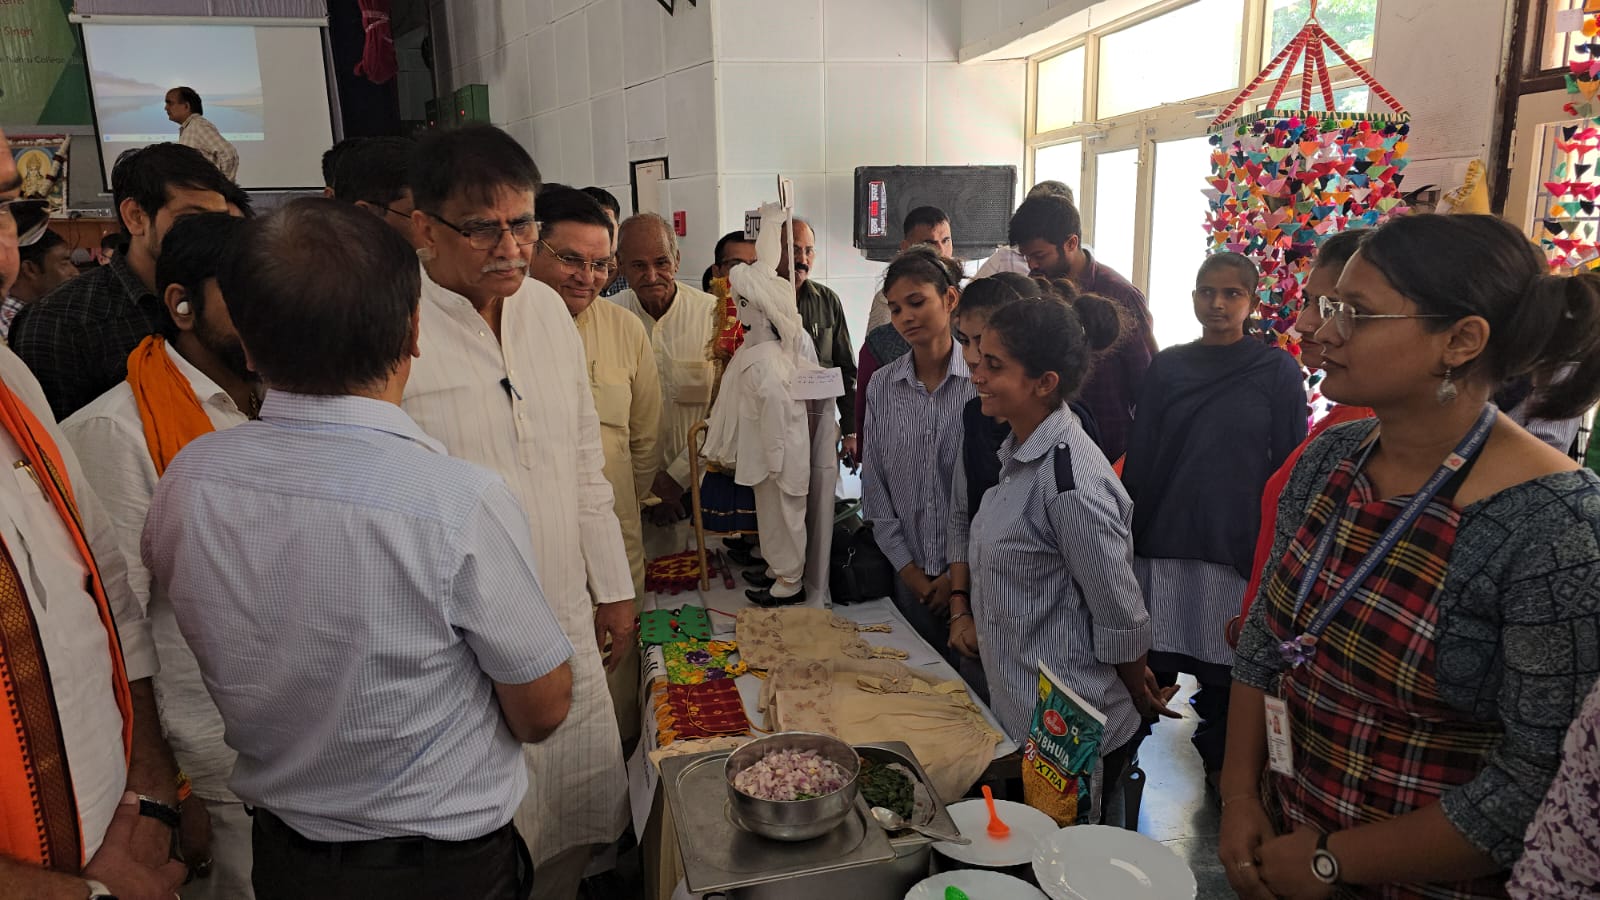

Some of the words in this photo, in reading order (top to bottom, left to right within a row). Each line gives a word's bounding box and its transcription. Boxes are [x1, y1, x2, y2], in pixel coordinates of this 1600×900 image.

[1314, 535, 1330, 562] ADVANCED
[1345, 565, 1368, 591] ADVANCED
[1364, 546, 1383, 567] STUDIES
[1402, 492, 1428, 520] EDUCATION
[1036, 758, 1062, 789] XTRA
